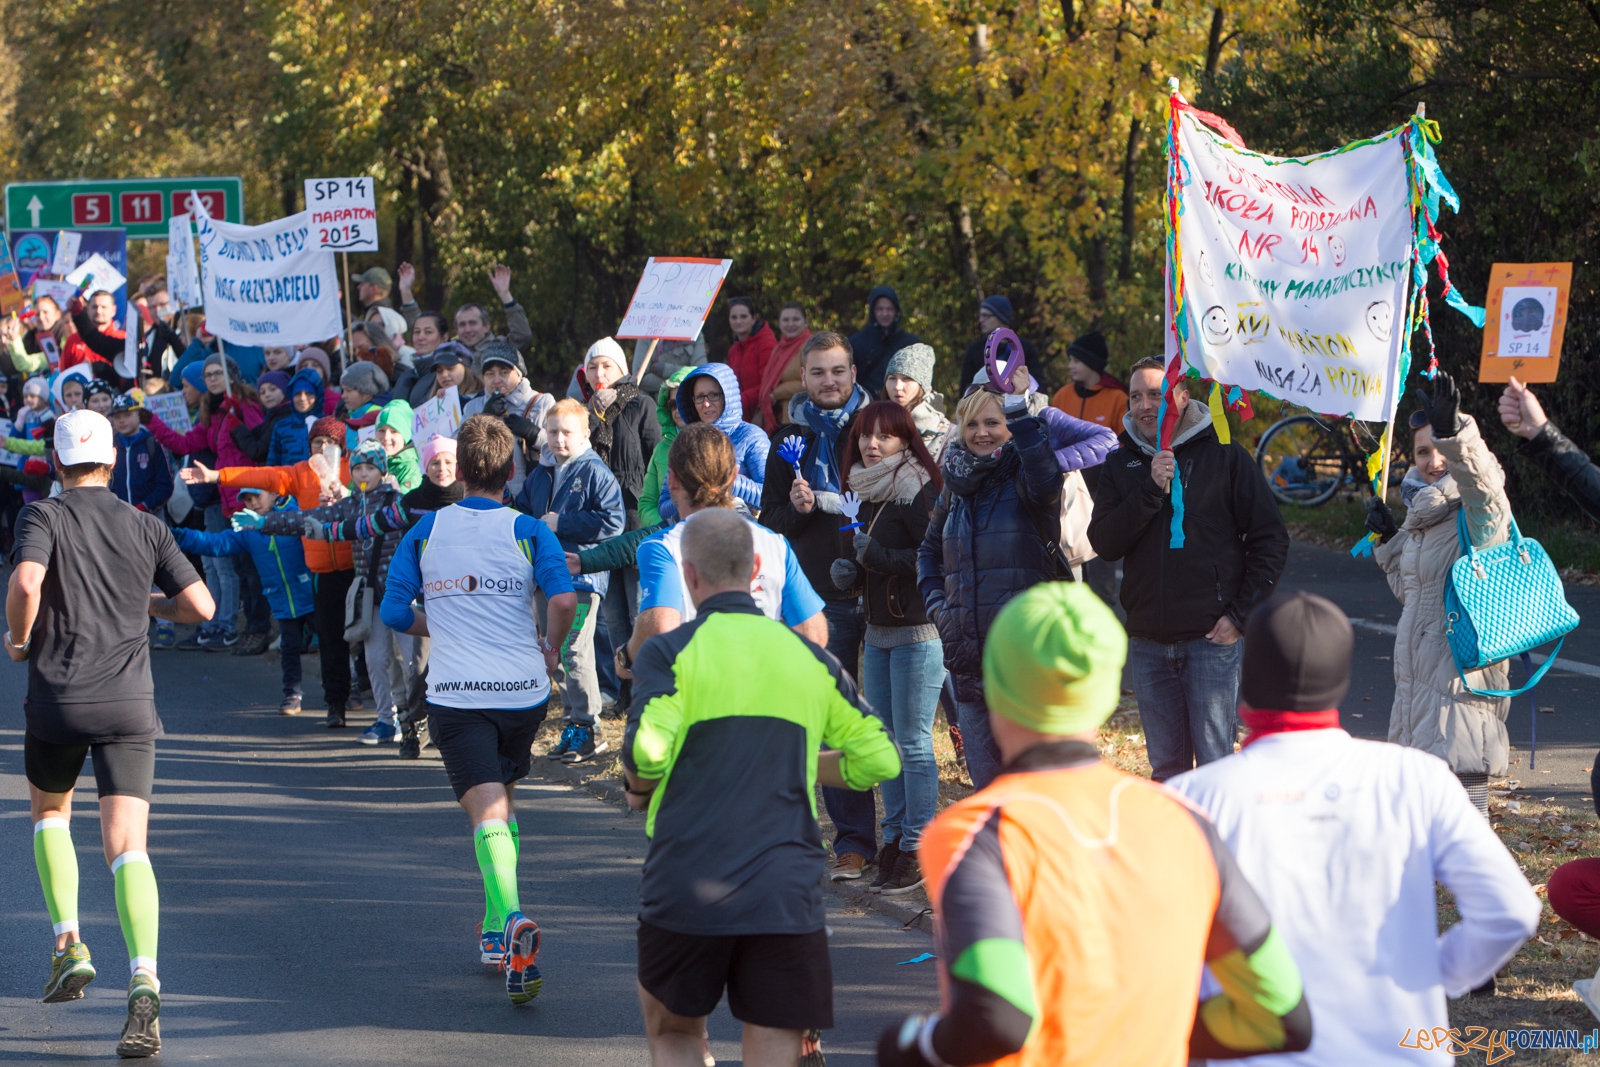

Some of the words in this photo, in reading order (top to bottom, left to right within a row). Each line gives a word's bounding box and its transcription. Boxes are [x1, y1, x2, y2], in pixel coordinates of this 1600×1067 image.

[315, 181, 340, 201] SP
[345, 179, 366, 198] 14
[85, 198, 100, 221] 5
[131, 196, 151, 219] 11
[312, 207, 376, 224] MARATON
[319, 224, 361, 244] 2015
[1238, 229, 1282, 262] NR
[1300, 234, 1320, 266] 14
[240, 273, 320, 304] PRZYJACIELU
[1507, 342, 1523, 354] SP
[1526, 342, 1540, 354] 14
[434, 678, 539, 693] WWW.MACROLOGIC.PL
